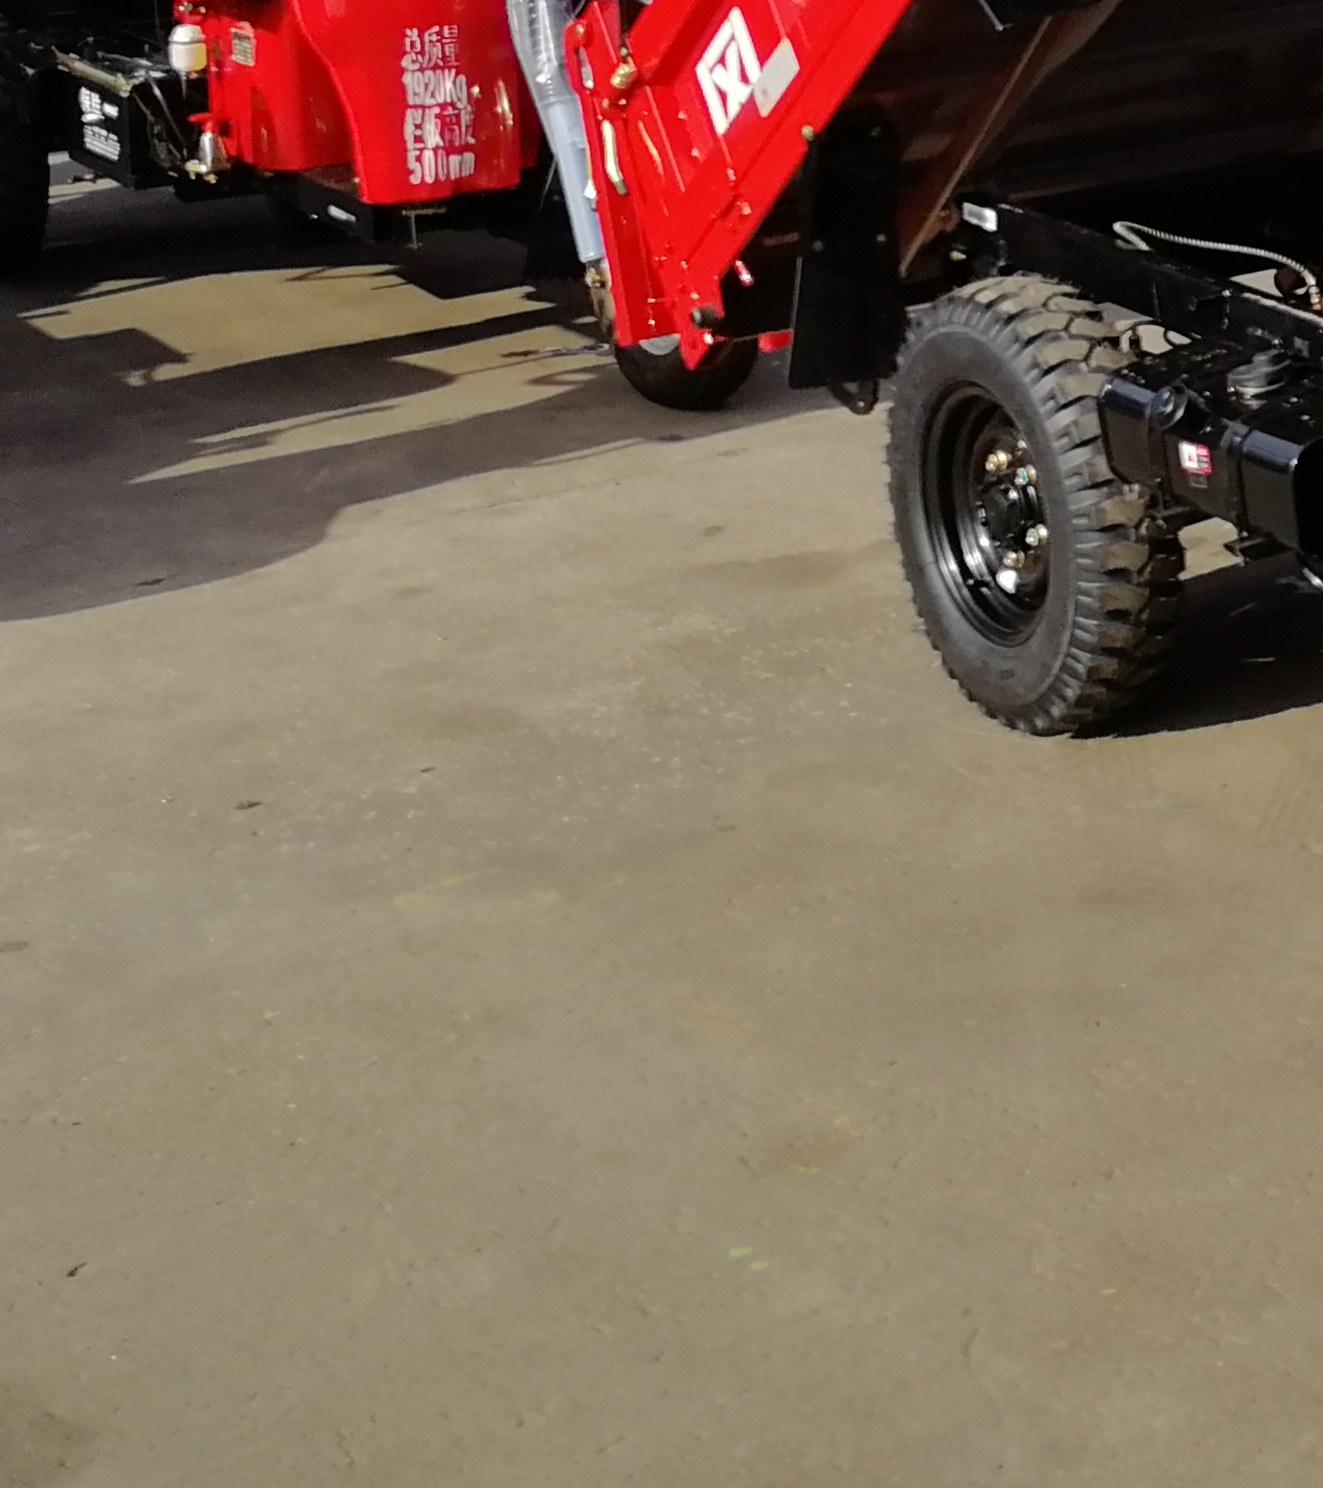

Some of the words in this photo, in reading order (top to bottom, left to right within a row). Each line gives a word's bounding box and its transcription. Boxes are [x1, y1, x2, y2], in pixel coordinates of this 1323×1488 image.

[400, 24, 460, 71] 总质量
[695, 5, 761, 136] 风
[401, 68, 468, 109] 1920Kg
